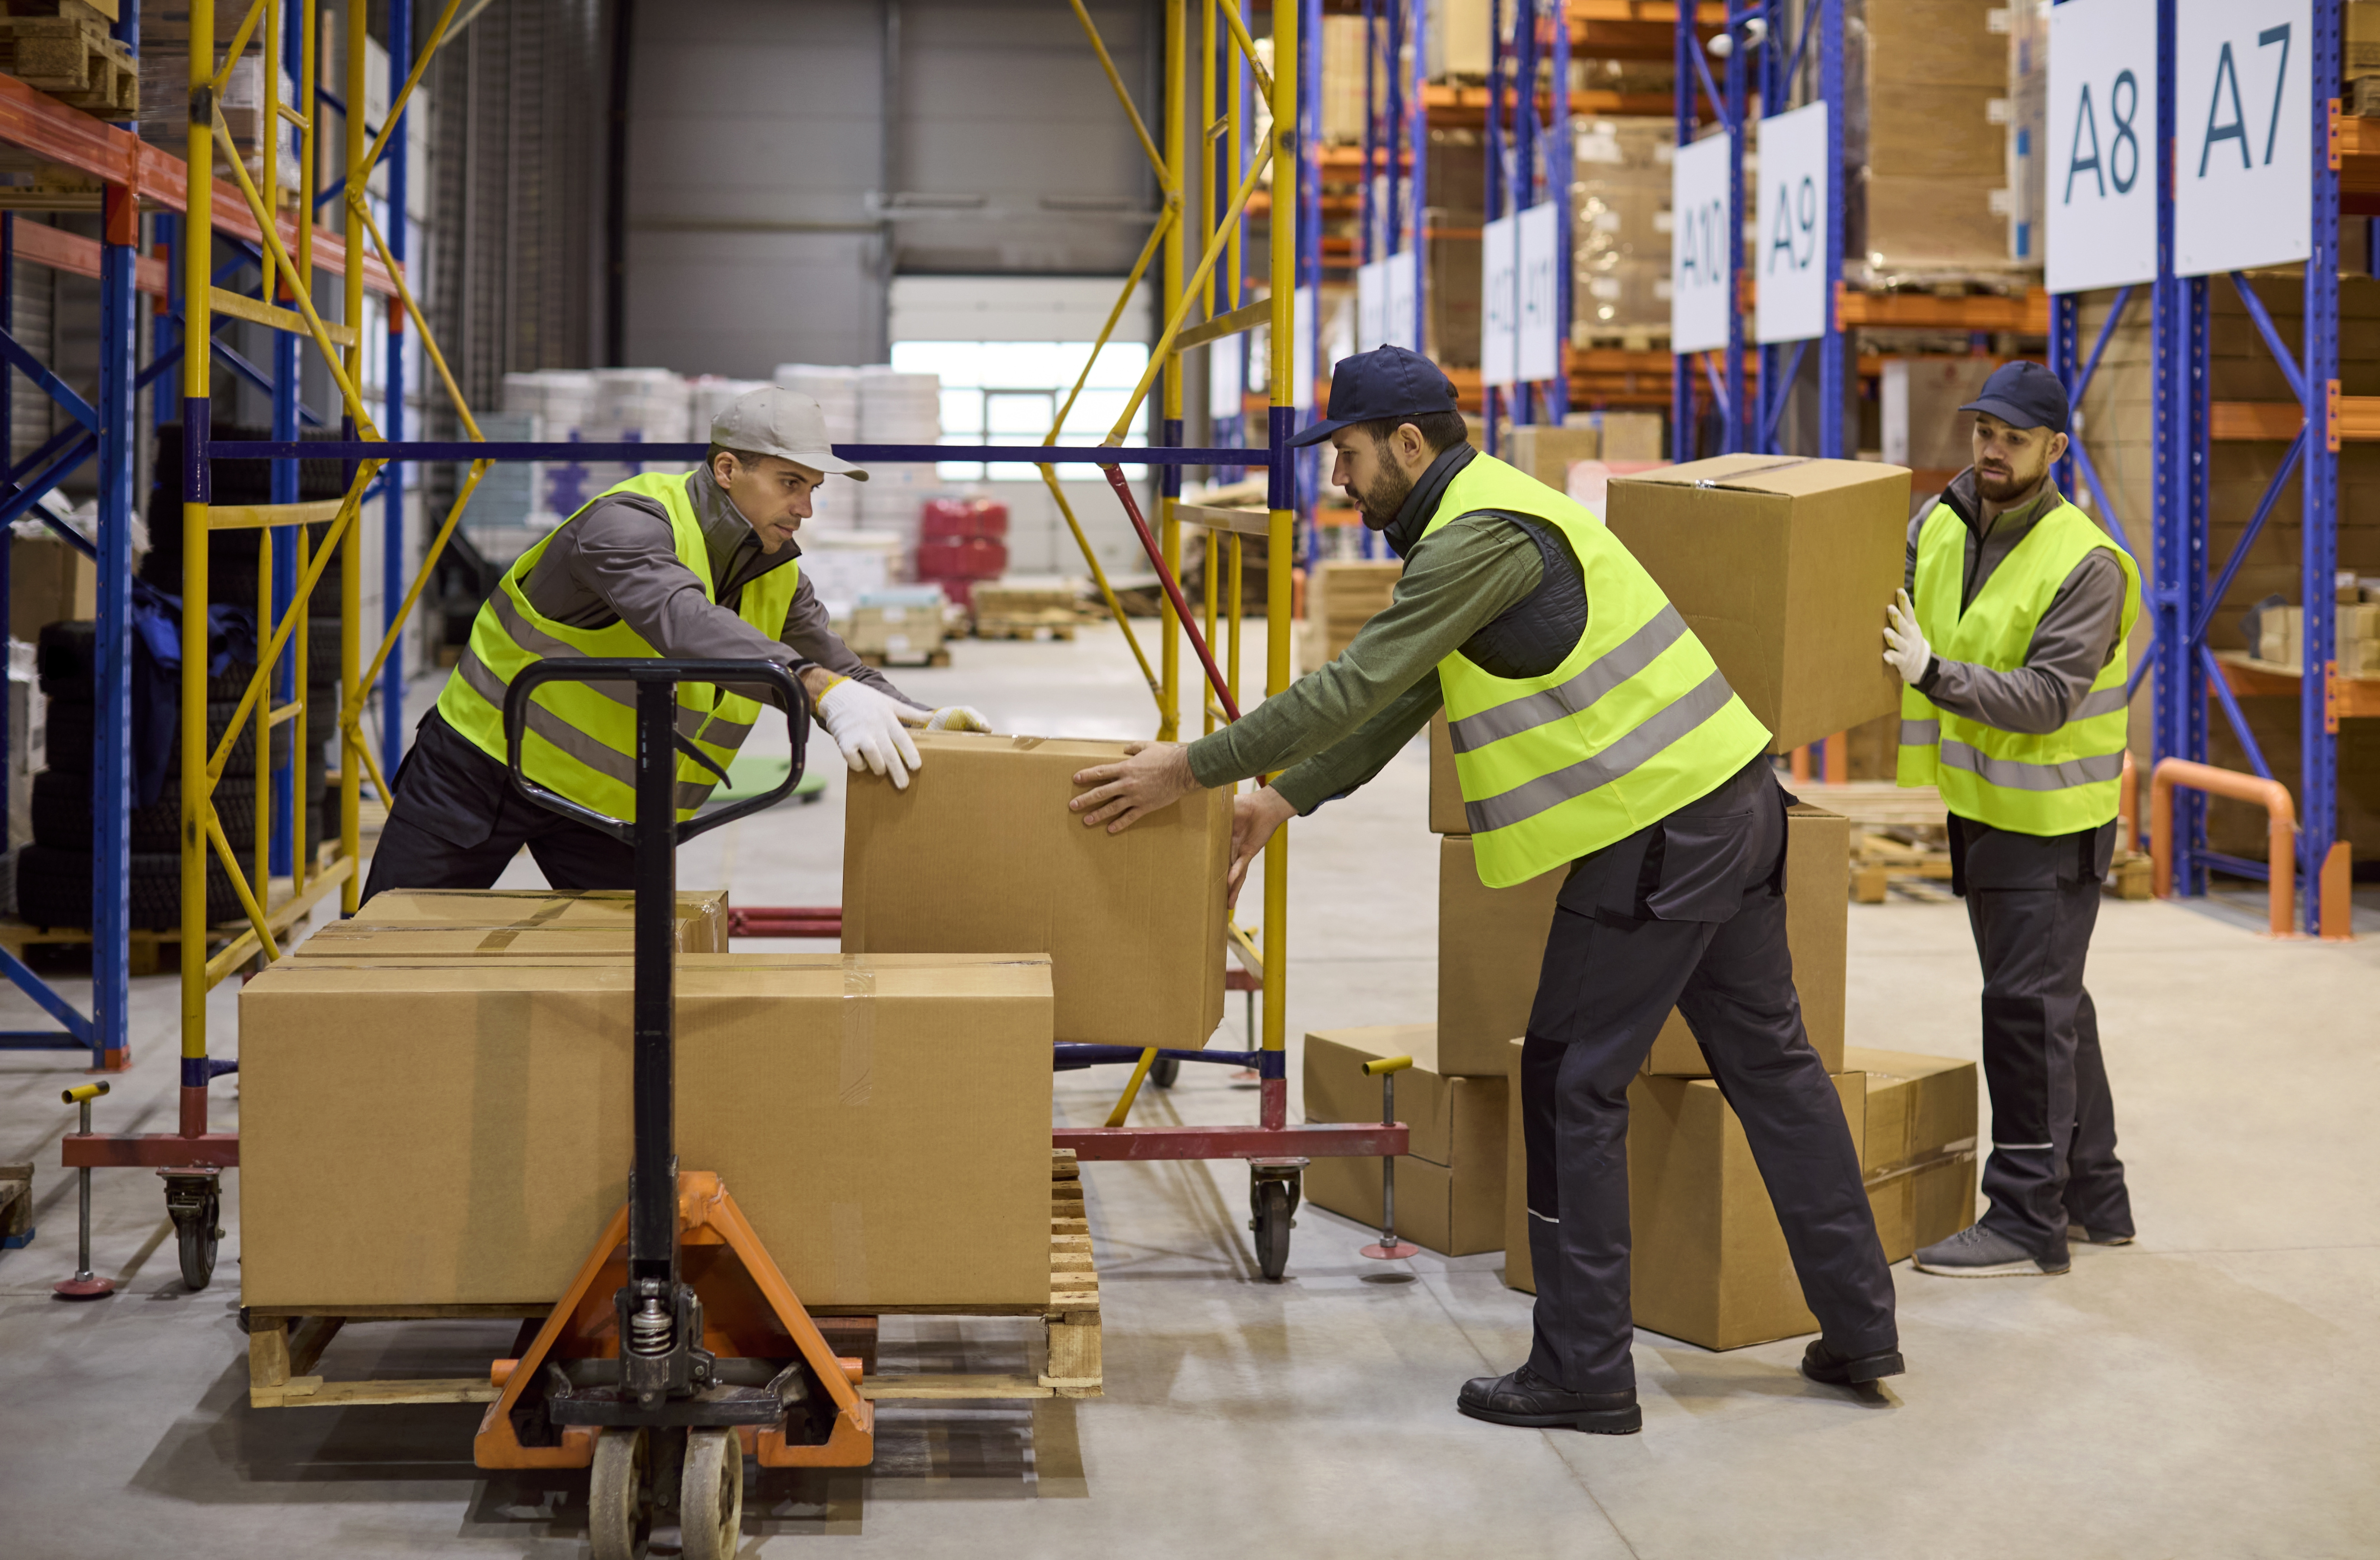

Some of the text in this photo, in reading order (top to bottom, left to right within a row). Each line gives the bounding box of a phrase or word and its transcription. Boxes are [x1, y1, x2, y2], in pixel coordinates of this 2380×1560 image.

[2063, 68, 2139, 205] A8
[2198, 22, 2291, 178] A7
[1676, 198, 1724, 289] A10
[1767, 174, 1816, 276] A9
